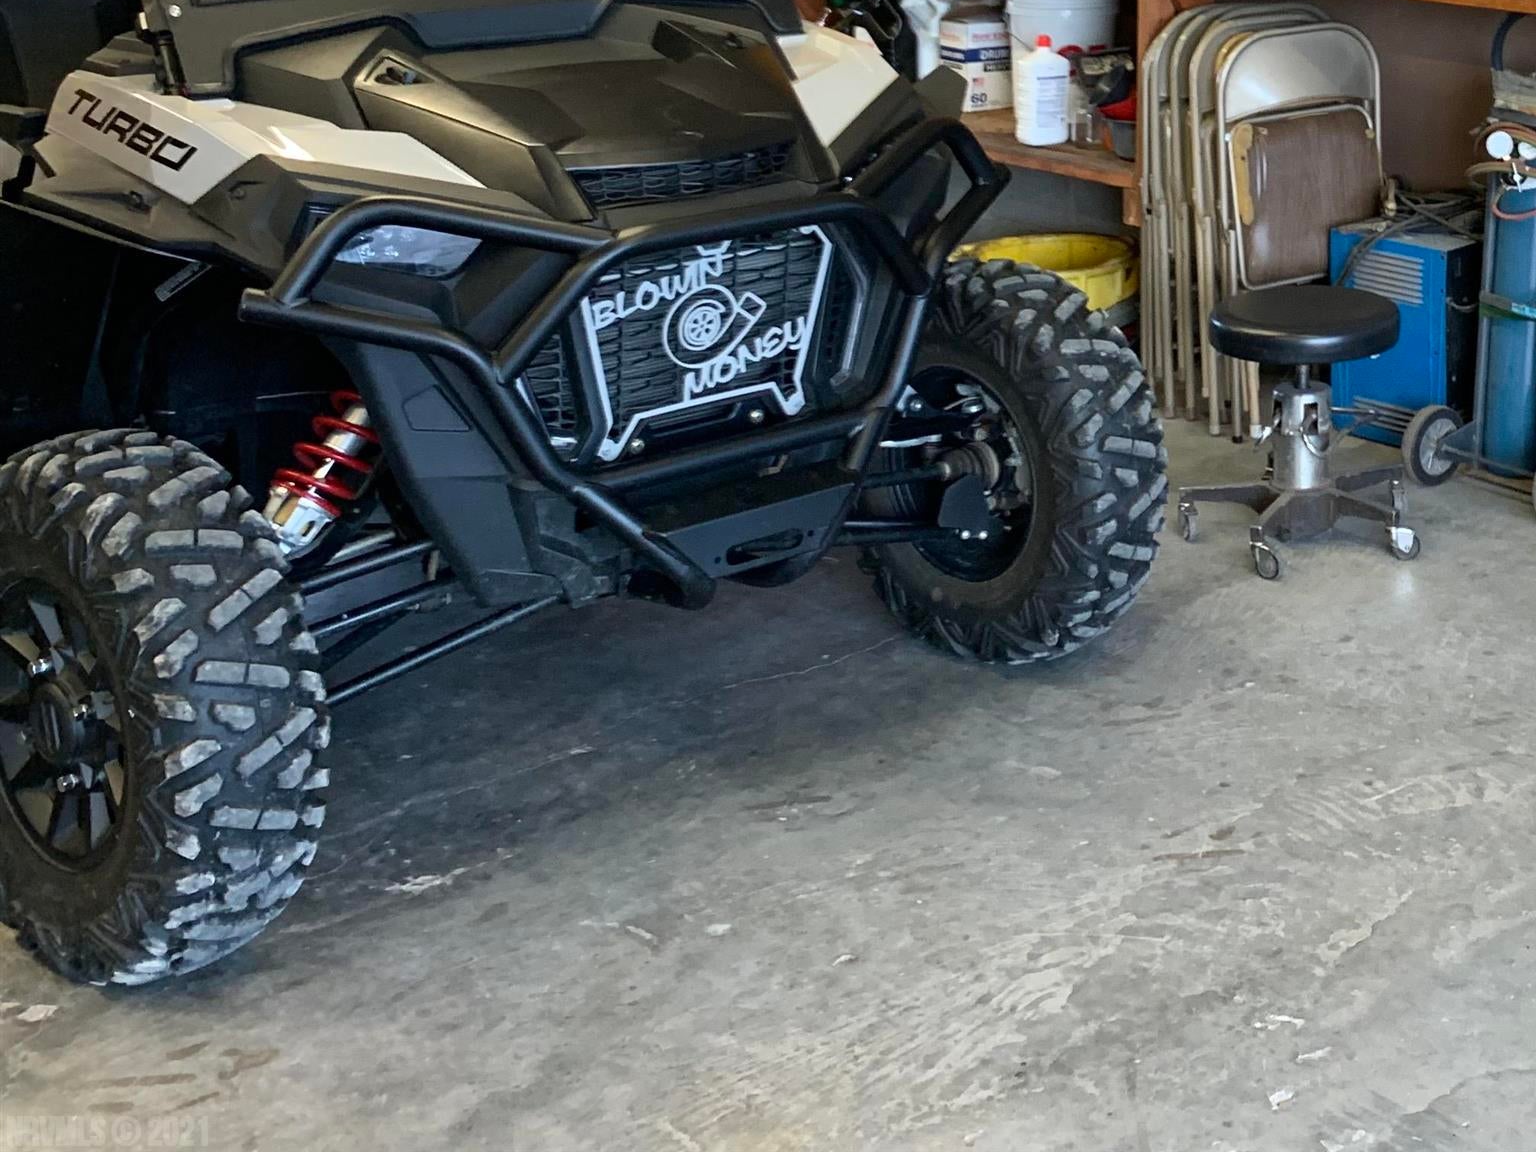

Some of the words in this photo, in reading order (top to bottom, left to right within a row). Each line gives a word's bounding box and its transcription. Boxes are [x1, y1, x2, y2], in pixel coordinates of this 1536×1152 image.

[67, 88, 199, 172] TURBO
[971, 92, 988, 104] 60
[684, 316, 807, 402] MONEY
